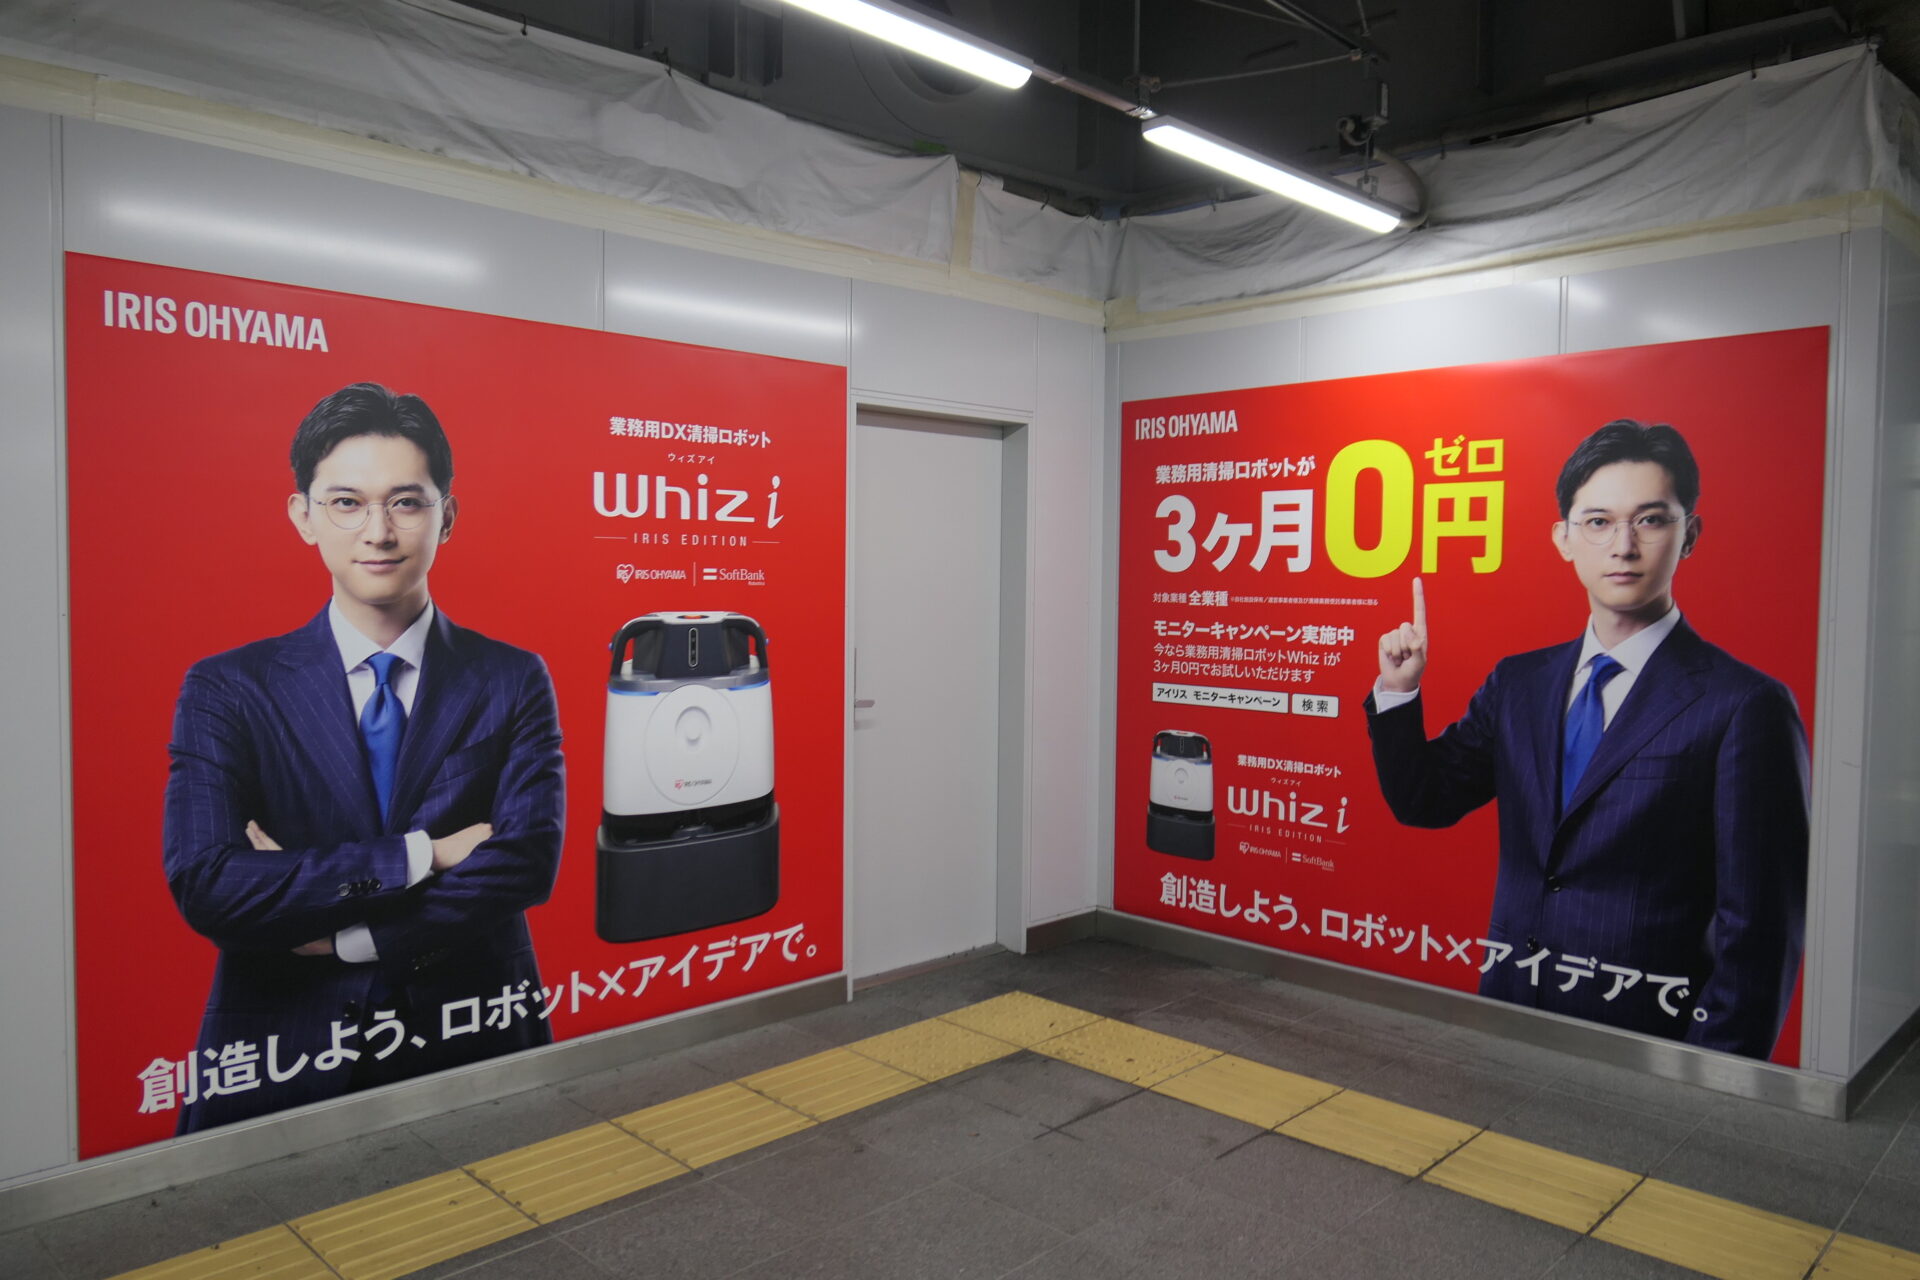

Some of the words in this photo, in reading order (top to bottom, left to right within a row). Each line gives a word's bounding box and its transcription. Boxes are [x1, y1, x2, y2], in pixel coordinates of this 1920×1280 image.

[104, 290, 177, 334] IRIS
[185, 301, 329, 353] OHYAMA
[609, 416, 772, 449] 業務用DX清掃ロボット
[1135, 417, 1166, 441] IRIS
[1169, 410, 1238, 438] OHYAMA
[1424, 434, 1504, 477] ゼロ
[1155, 455, 1316, 485] 業務用清掃ロボットが
[633, 532, 670, 545] IRIS
[681, 533, 748, 547] EDITION
[719, 568, 765, 581] SoftBank
[1153, 620, 1355, 647] モニターキャンペーン実施中
[1156, 687, 1188, 699] アイリス
[1193, 690, 1281, 707] モニターキャンペーン
[1301, 698, 1329, 713] 検索
[1237, 754, 1342, 778] 業務用DX清掃ロボット
[1278, 829, 1323, 843] EDITION
